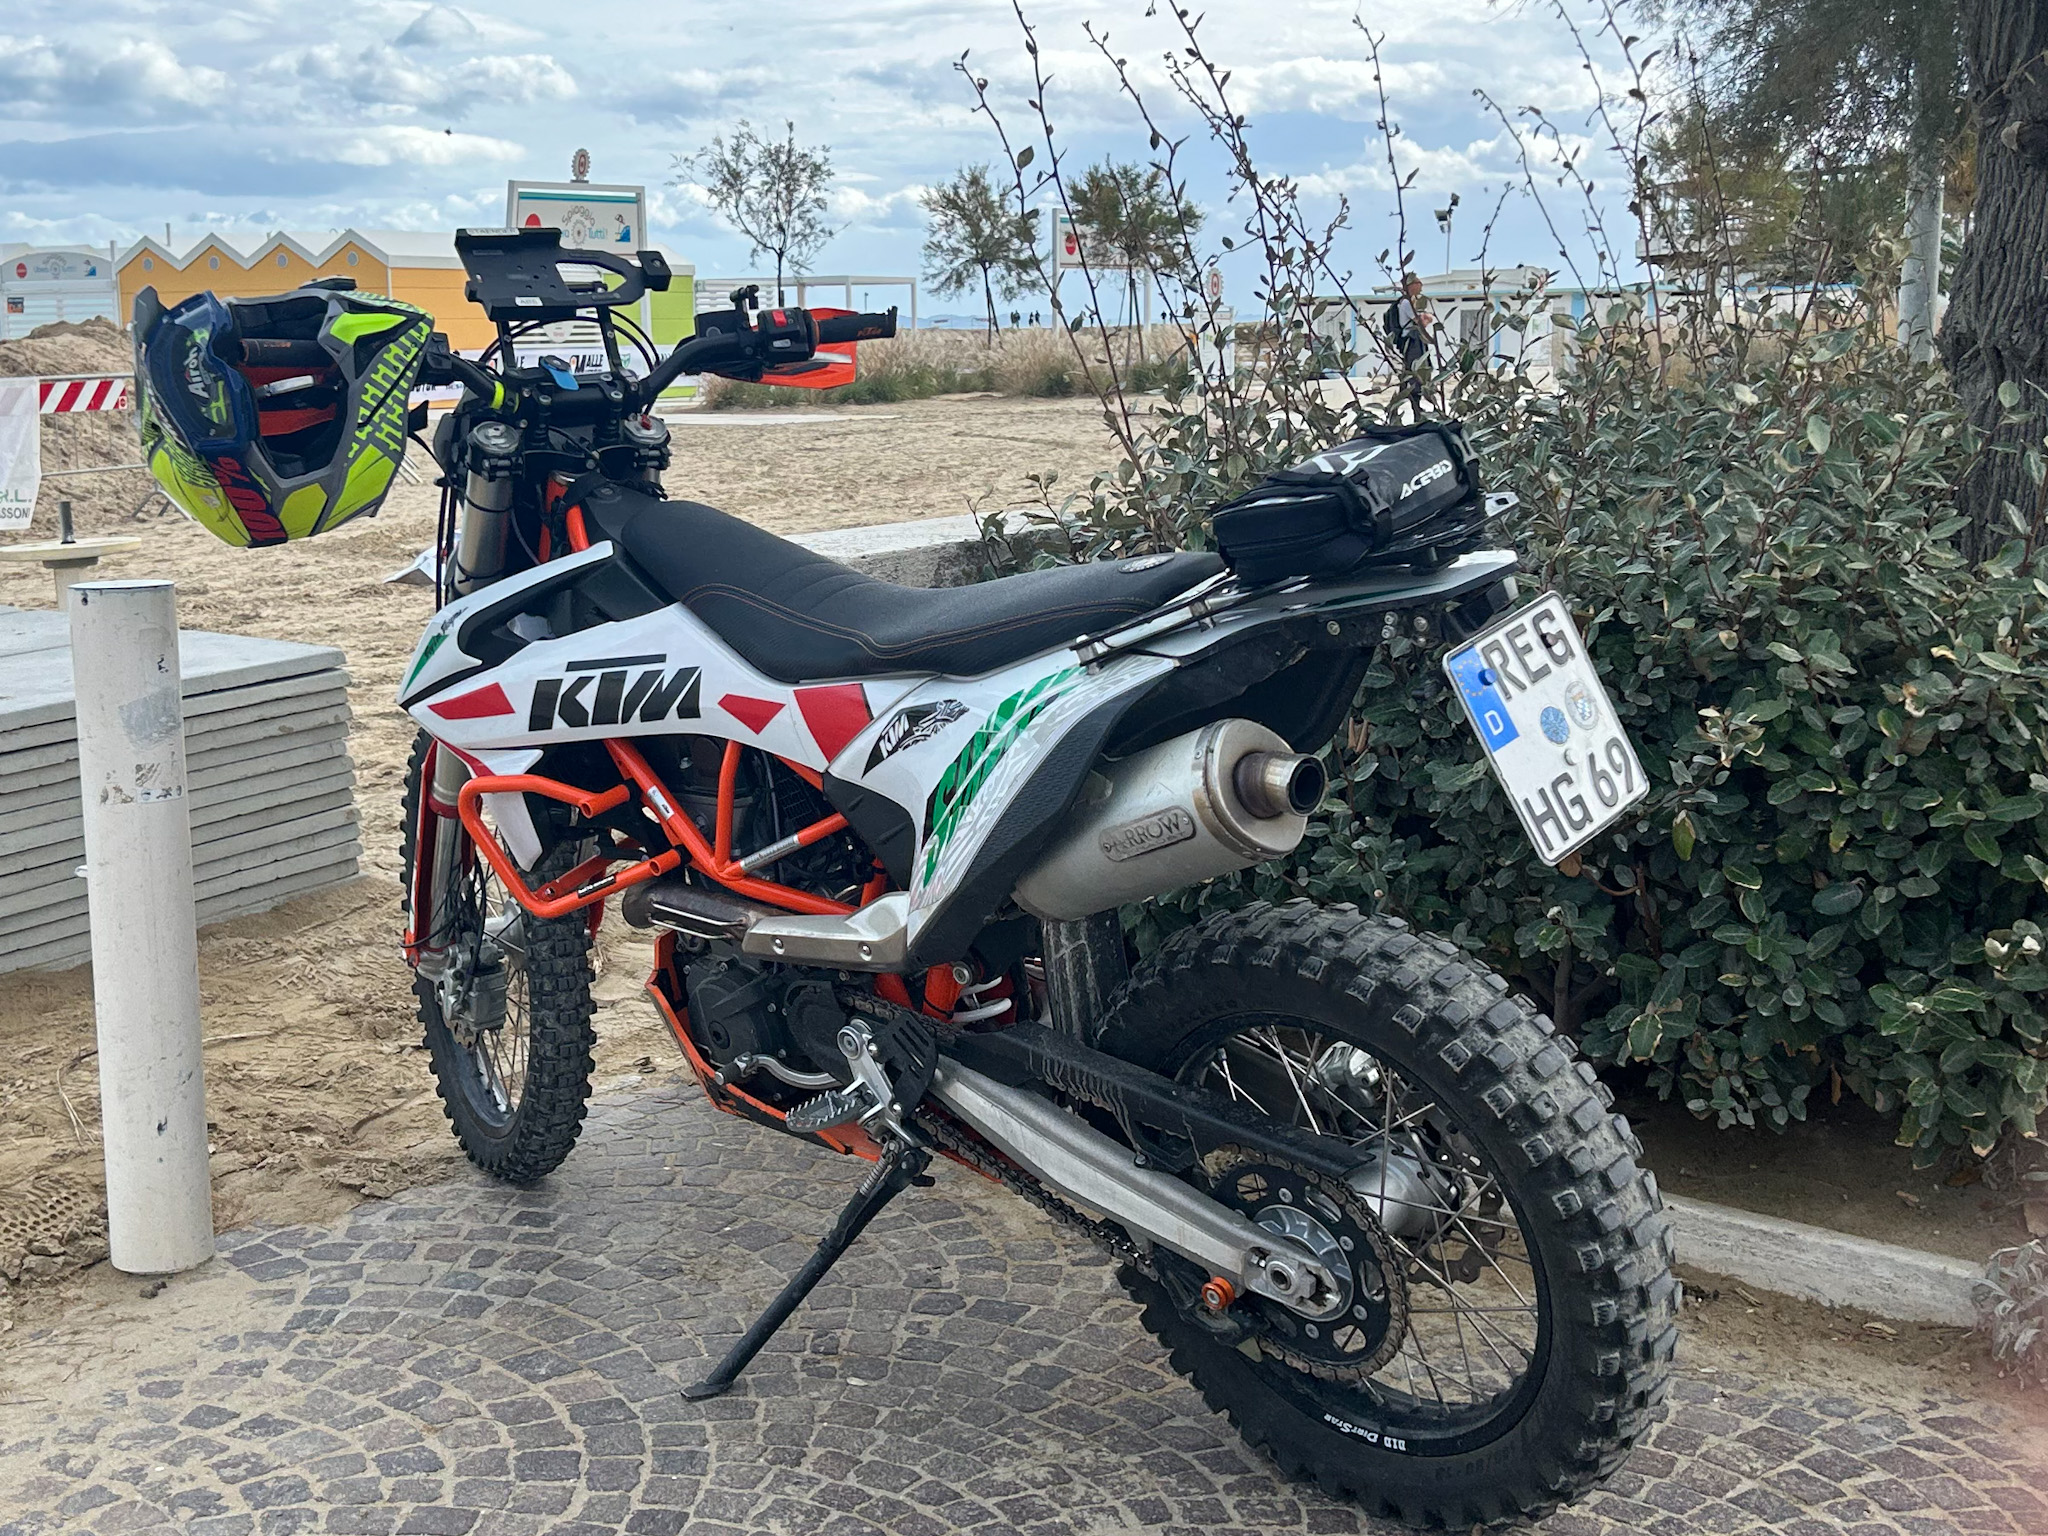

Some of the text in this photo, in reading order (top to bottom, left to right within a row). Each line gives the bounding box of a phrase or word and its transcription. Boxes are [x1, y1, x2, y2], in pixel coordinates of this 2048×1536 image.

[211, 456, 287, 541] 100%
[529, 653, 702, 732] KTM
[1481, 608, 1576, 701] REG
[878, 713, 910, 760] KTM
[1484, 709, 1504, 736] D
[1523, 736, 1634, 851] HG 69
[1383, 1436, 1407, 1452] DID
